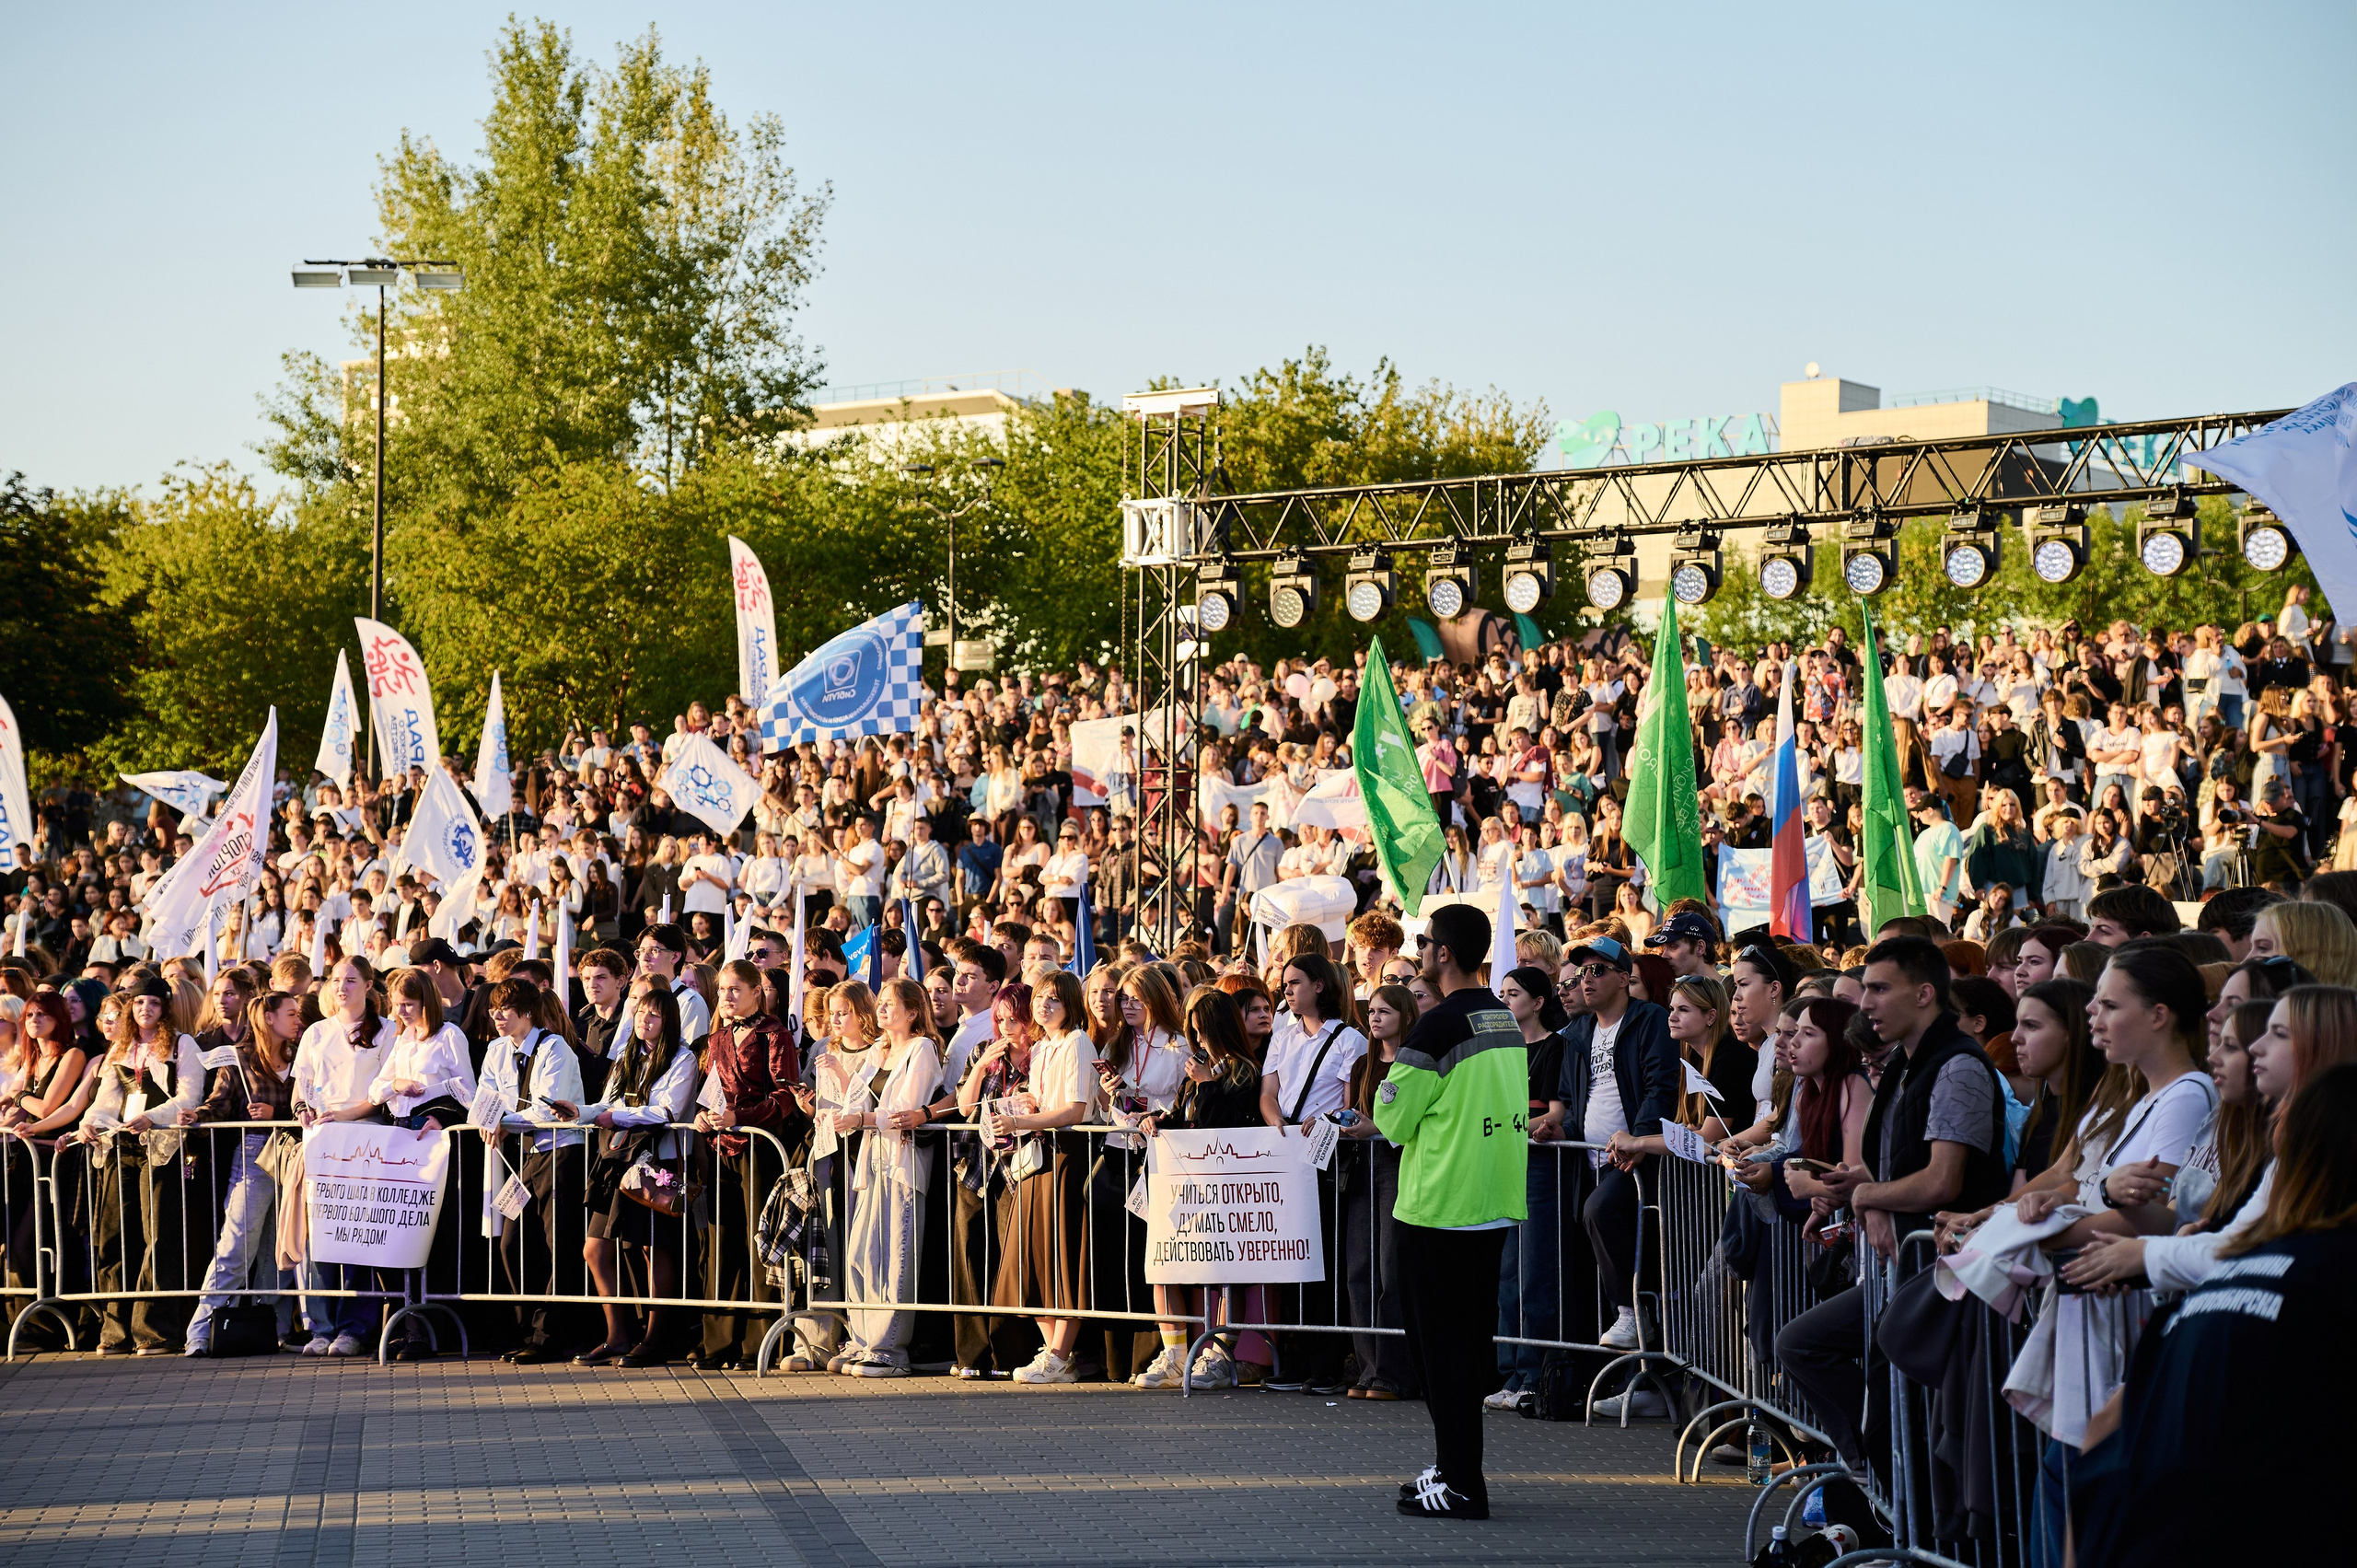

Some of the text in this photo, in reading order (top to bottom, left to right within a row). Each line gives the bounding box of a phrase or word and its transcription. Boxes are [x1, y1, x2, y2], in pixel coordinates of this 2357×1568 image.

[1632, 412, 1770, 462] РЕКА
[316, 1182, 346, 1200] ЕРВОГО
[347, 1184, 368, 1201] ШАГА
[370, 1186, 376, 1202] В
[377, 1187, 436, 1208] КОЛЛЕДЖЕ
[1170, 1184, 1219, 1204] УЧИТЬСЯ
[1221, 1181, 1284, 1206] ОТКРЫТО,
[349, 1205, 396, 1225] БОЛЬШОГО
[397, 1210, 430, 1228] ДЕЛА
[1177, 1211, 1278, 1237] ДУМАТЬ СМЕЛО,
[334, 1226, 351, 1242] МЫ
[351, 1227, 388, 1247] РЯДОМ!
[1153, 1236, 1311, 1266] ДЕЙСТВОВАТЬ УВЕРЕННО!
